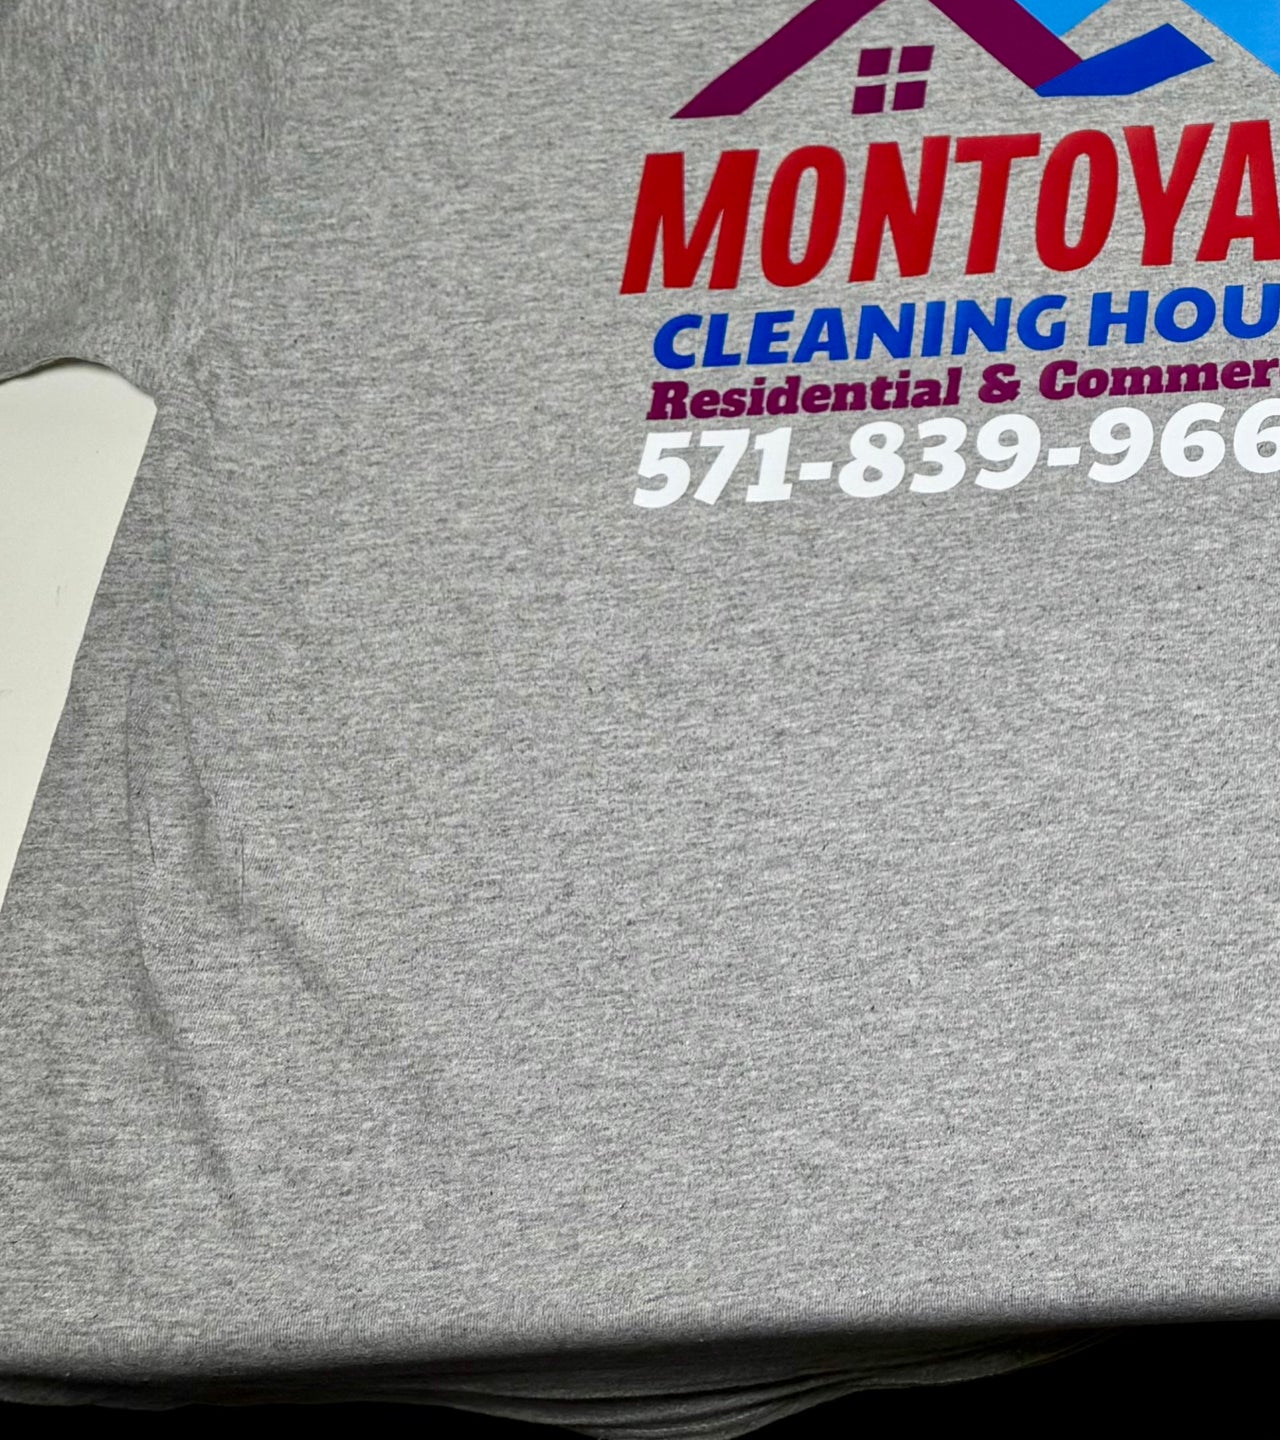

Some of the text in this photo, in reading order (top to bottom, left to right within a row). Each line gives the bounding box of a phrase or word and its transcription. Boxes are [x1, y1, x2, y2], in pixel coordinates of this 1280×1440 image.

[653, 293, 1067, 369] CLEANING
[645, 367, 963, 421] Residential
[978, 363, 1022, 404] &
